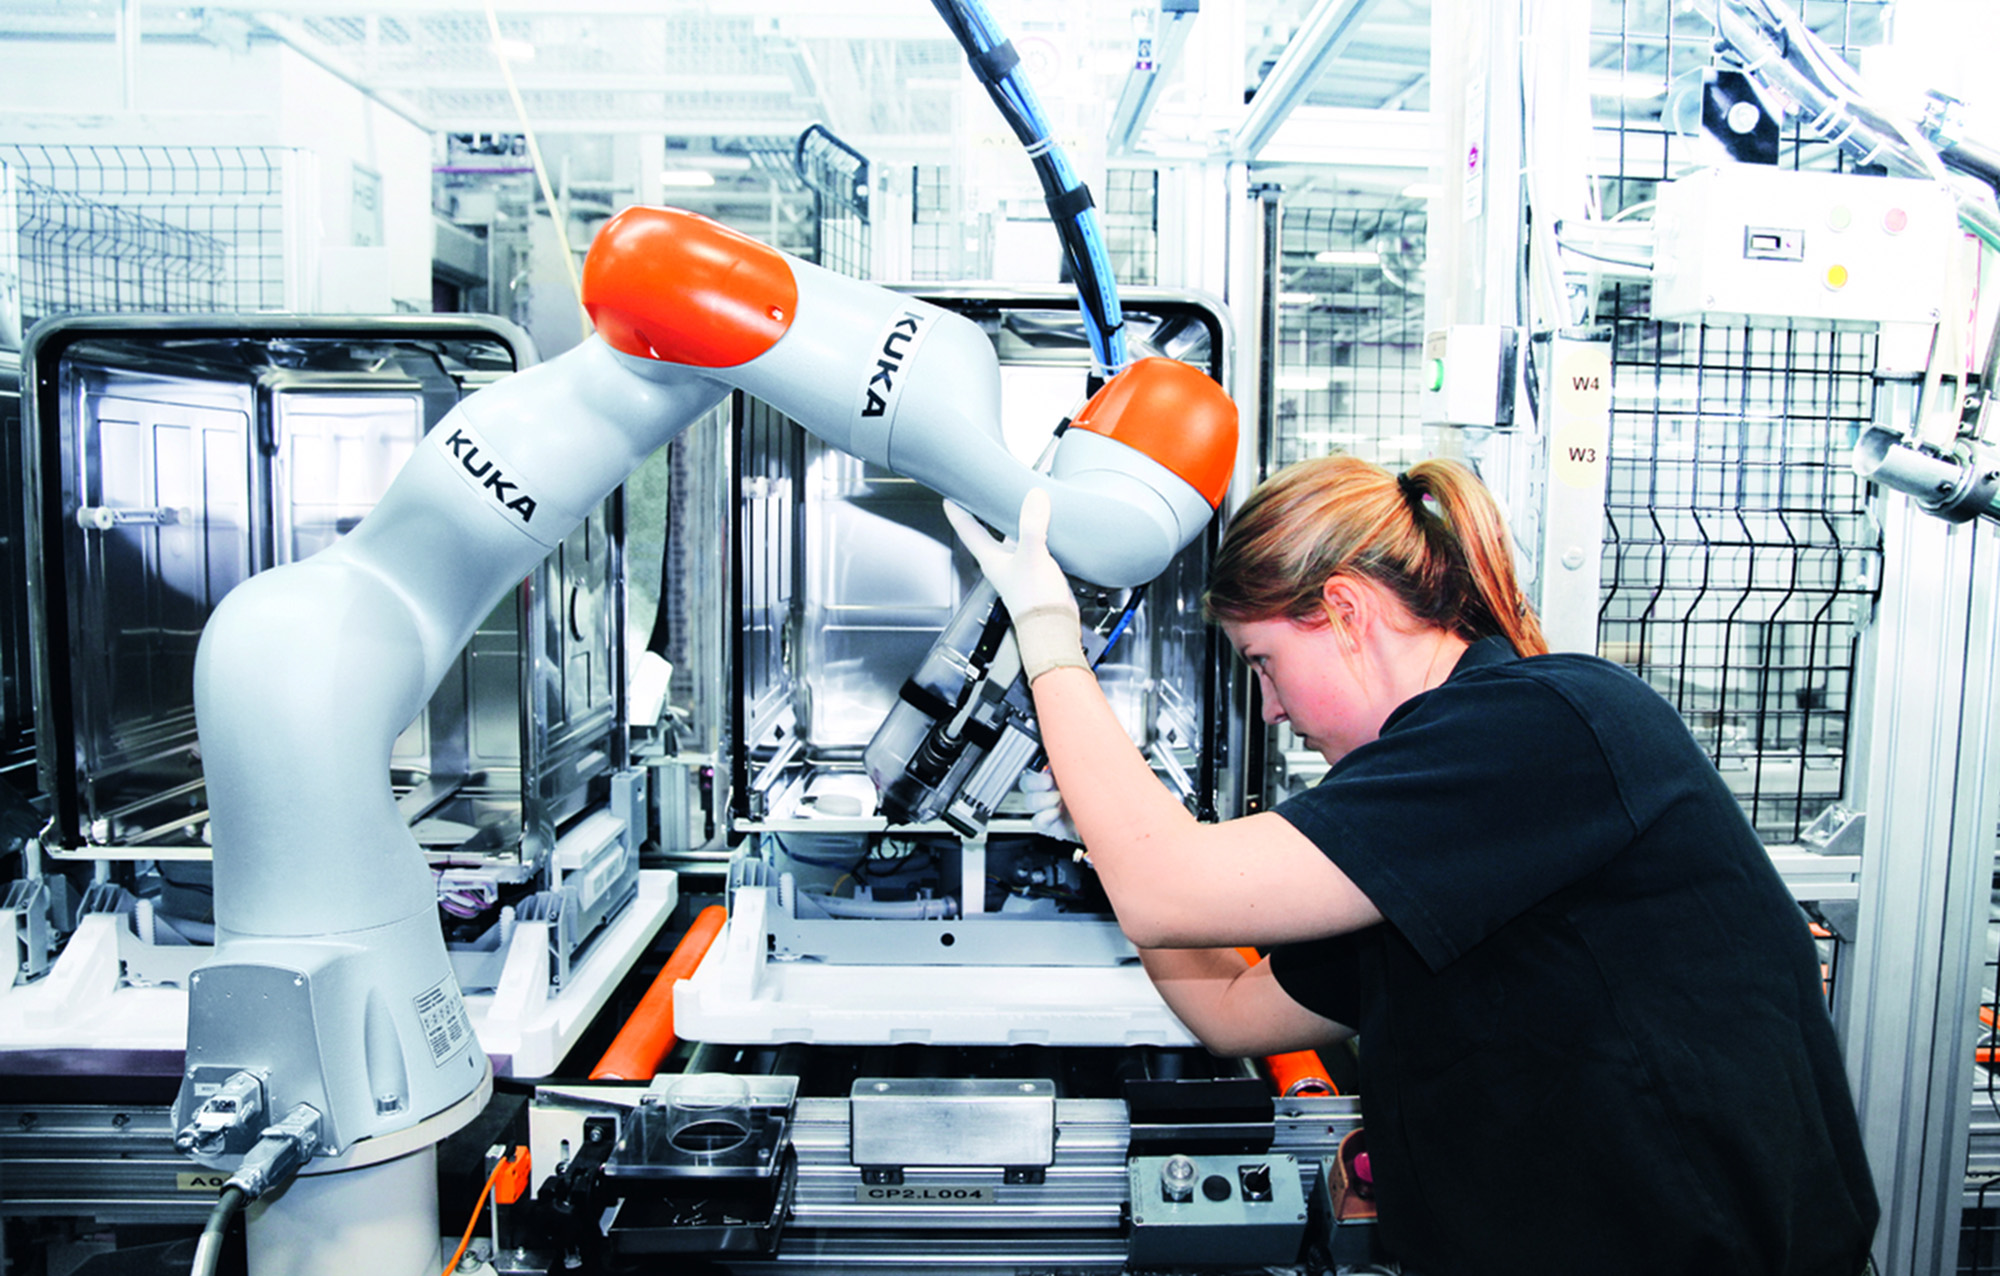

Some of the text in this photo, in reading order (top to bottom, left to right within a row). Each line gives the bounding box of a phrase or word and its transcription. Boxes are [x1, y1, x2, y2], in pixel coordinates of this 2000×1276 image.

[861, 310, 925, 418] KUKA
[1572, 376, 1600, 391] W4
[1568, 447, 1597, 463] W3
[445, 428, 538, 523] KUKA
[868, 1188, 982, 1200] CP2.L004
